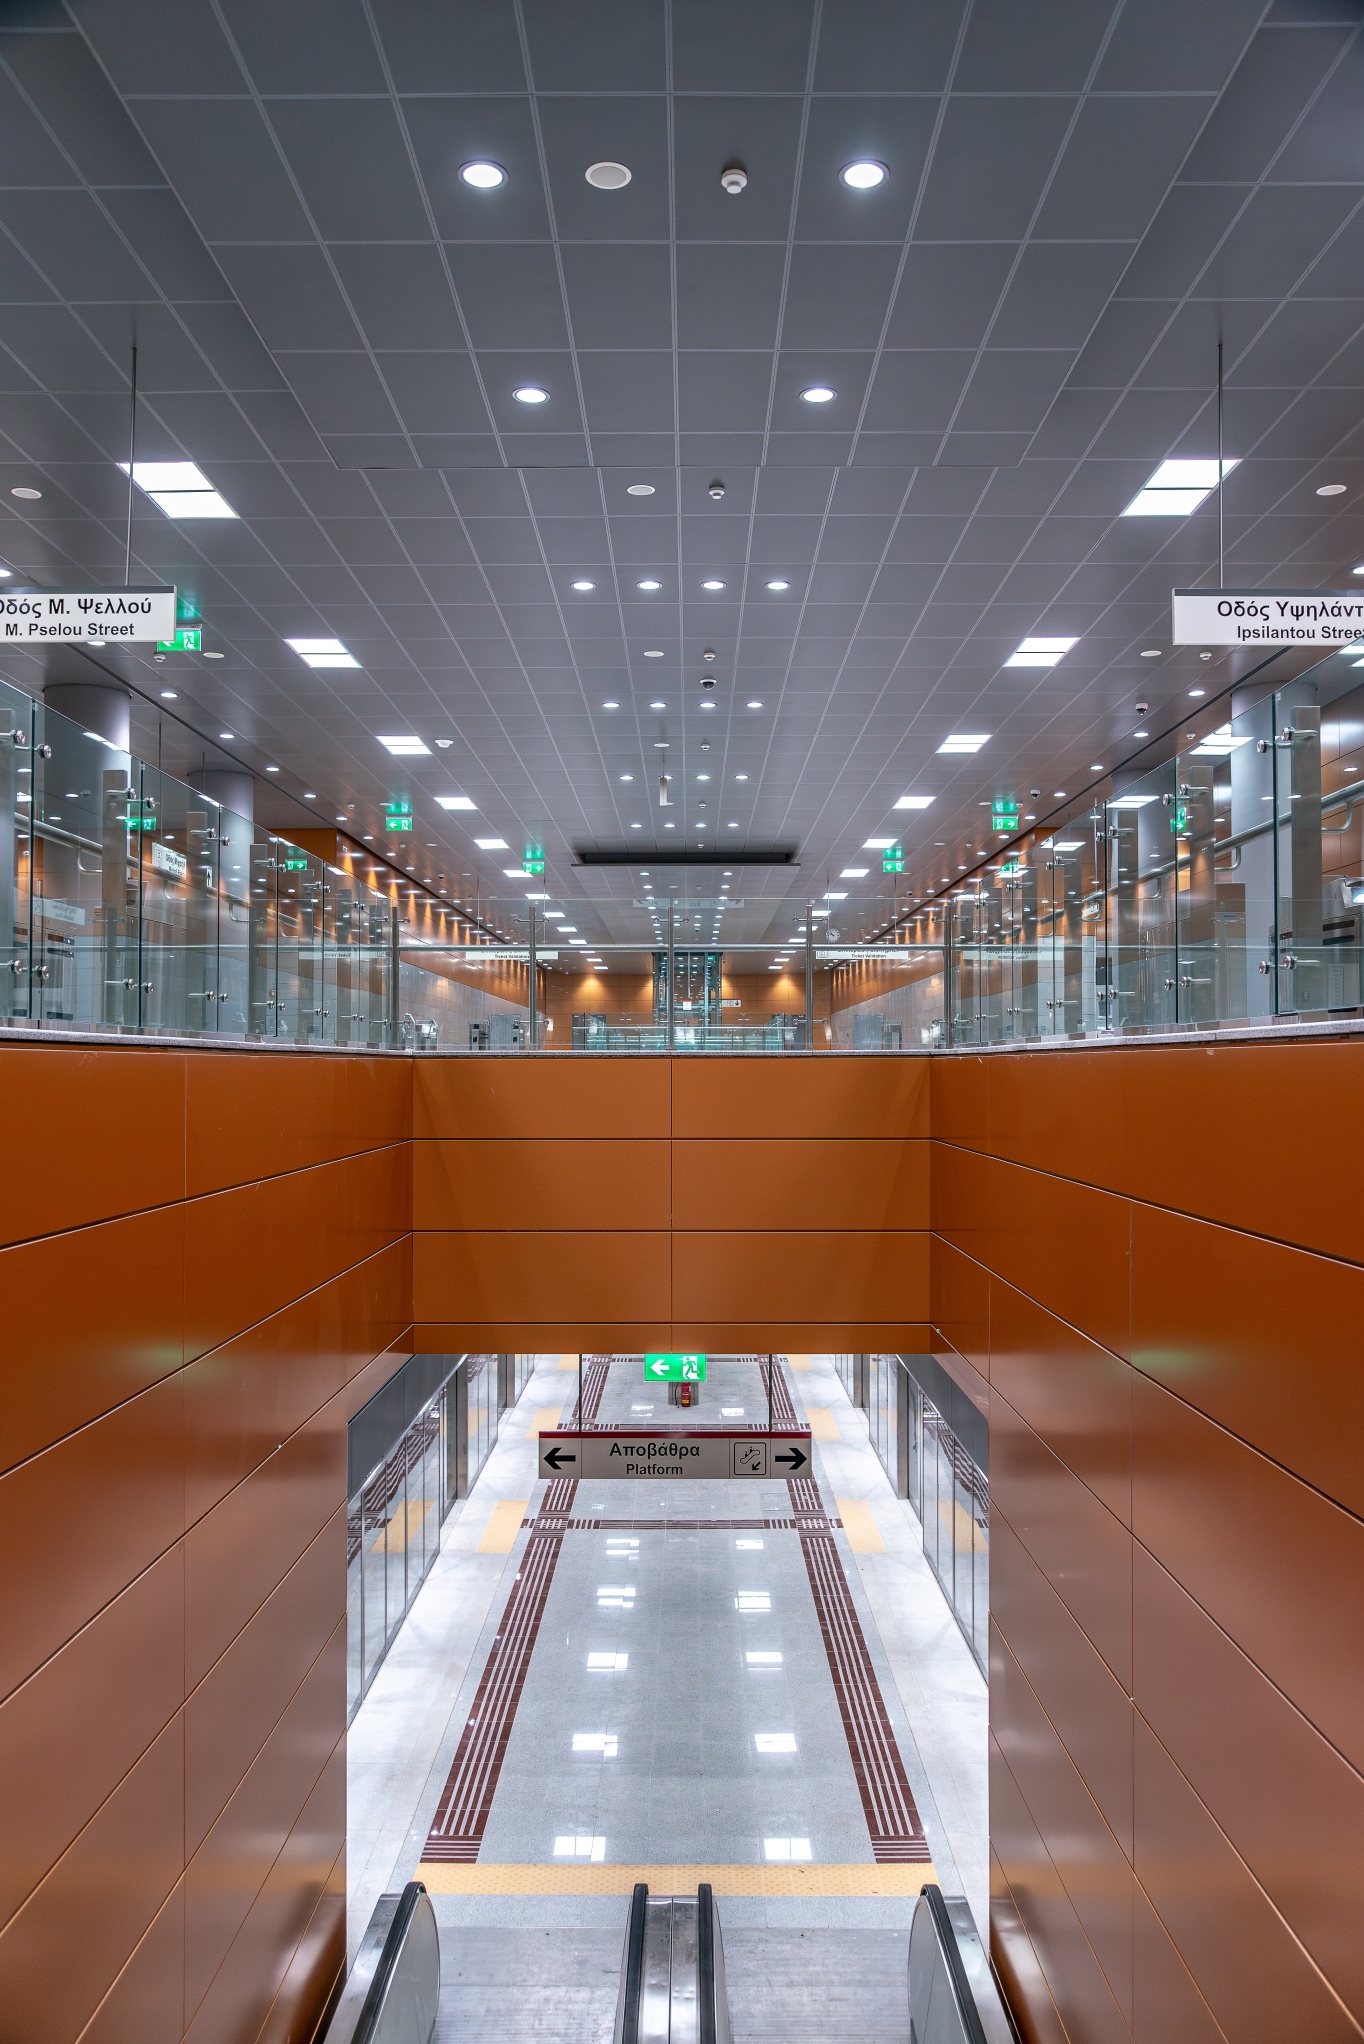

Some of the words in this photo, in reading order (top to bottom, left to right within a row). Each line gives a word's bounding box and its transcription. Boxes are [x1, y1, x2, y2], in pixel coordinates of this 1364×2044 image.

[49, 598, 70, 615] Μ.
[77, 598, 152, 615] Ψελλού
[1217, 600, 1270, 621] Οδός
[5, 623, 23, 636] M.
[28, 622, 82, 636] Pselou
[87, 622, 135, 636] Street
[1237, 625, 1316, 641] Ipsilantou
[1321, 625, 1364, 639] Stree
[609, 1442, 700, 1460] Αποβάθρα
[626, 1463, 683, 1475] Platform
